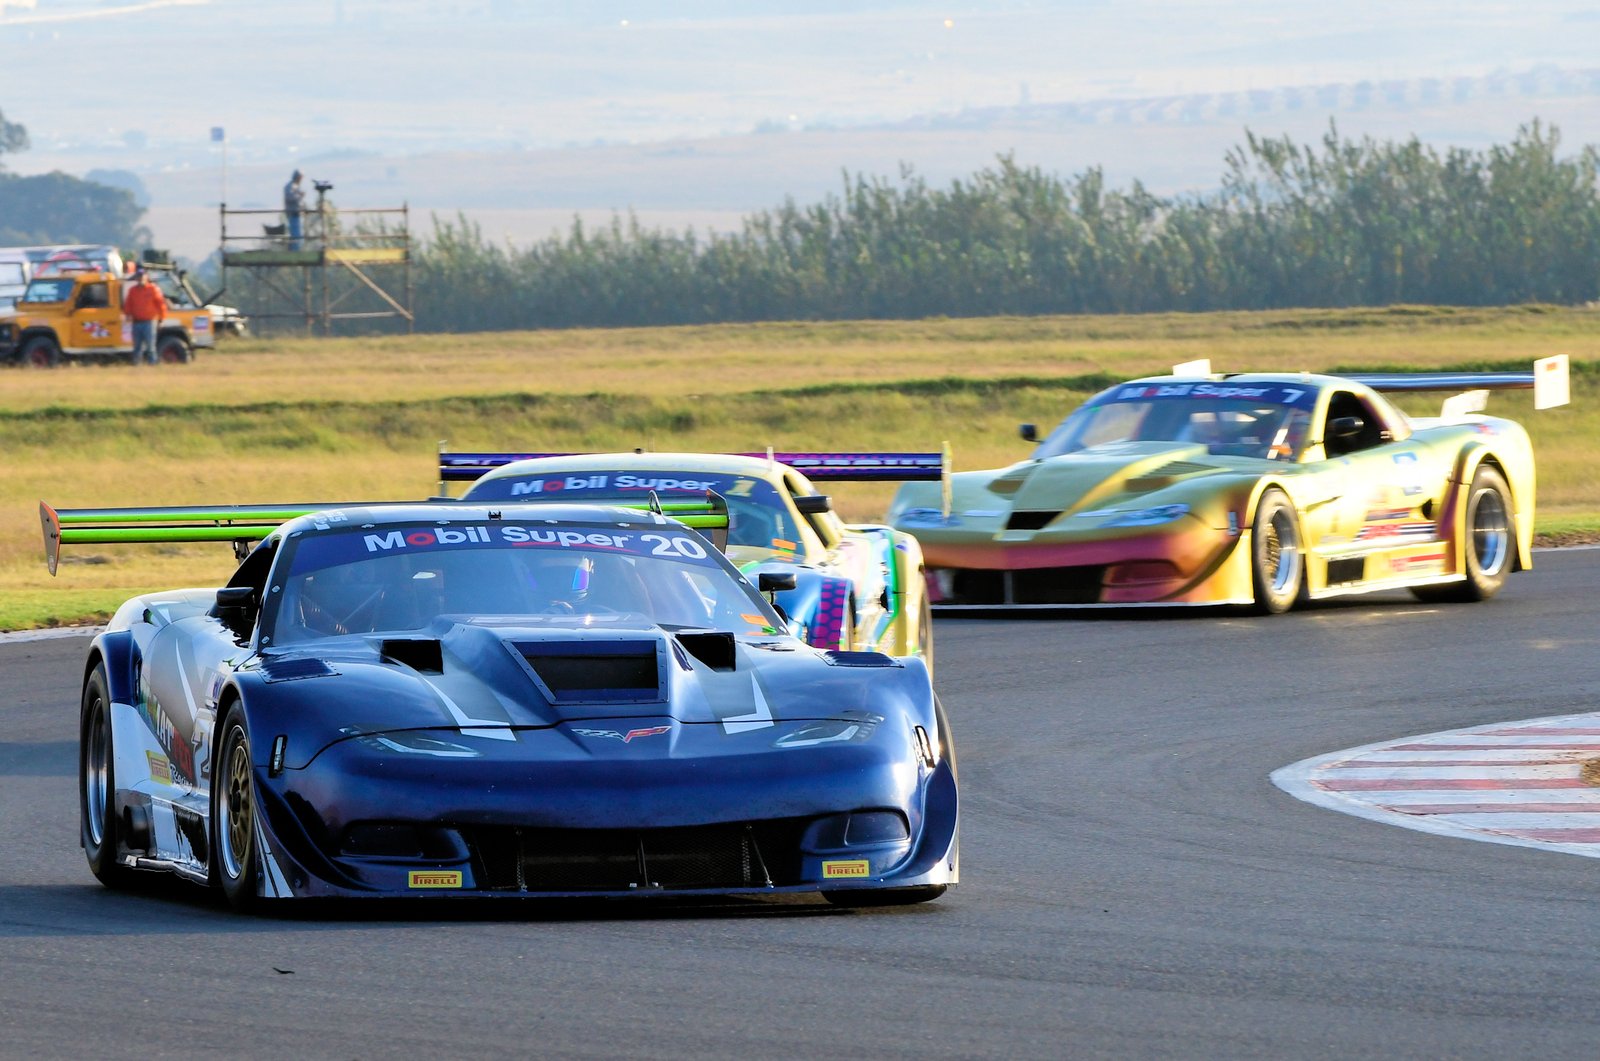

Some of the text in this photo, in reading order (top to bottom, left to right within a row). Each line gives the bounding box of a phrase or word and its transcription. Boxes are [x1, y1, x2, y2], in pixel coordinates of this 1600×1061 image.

[1117, 384, 1305, 403] Mobil Super 7
[510, 475, 756, 497] Mobil Super 1
[363, 526, 708, 559] Mobil Super 20
[827, 863, 865, 875] PIRELLI
[413, 874, 458, 885] PIRELLI
